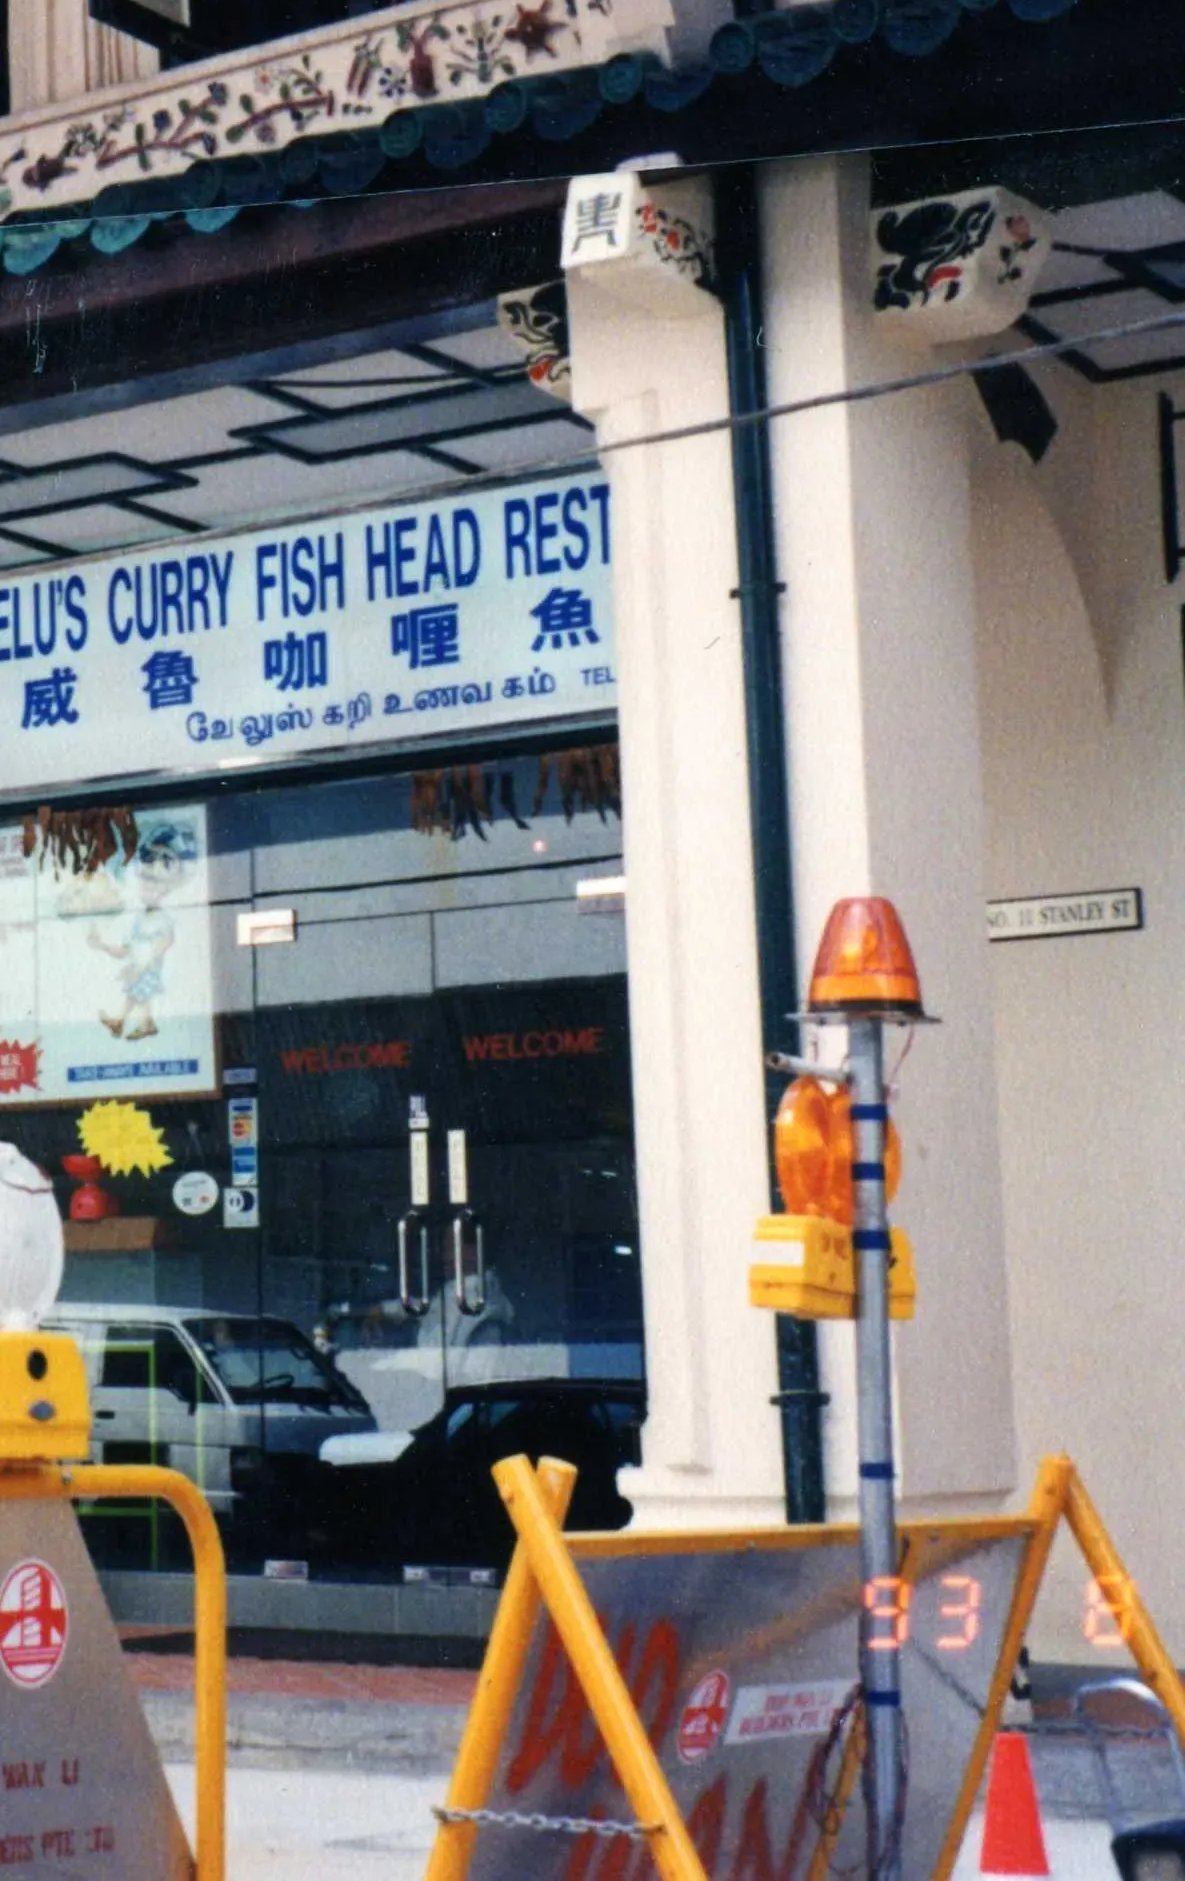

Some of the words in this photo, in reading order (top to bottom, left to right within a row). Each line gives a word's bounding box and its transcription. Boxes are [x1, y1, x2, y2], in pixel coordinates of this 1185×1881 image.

[108, 549, 235, 645] CURRY
[256, 531, 345, 622] FISH
[366, 507, 481, 602] HEAD
[503, 483, 611, 580] REST
[1038, 900, 1105, 926] STANLEY
[1112, 898, 1132, 919] ST
[280, 1039, 411, 1075] WELCOME
[463, 1026, 605, 1062] WELCOME
